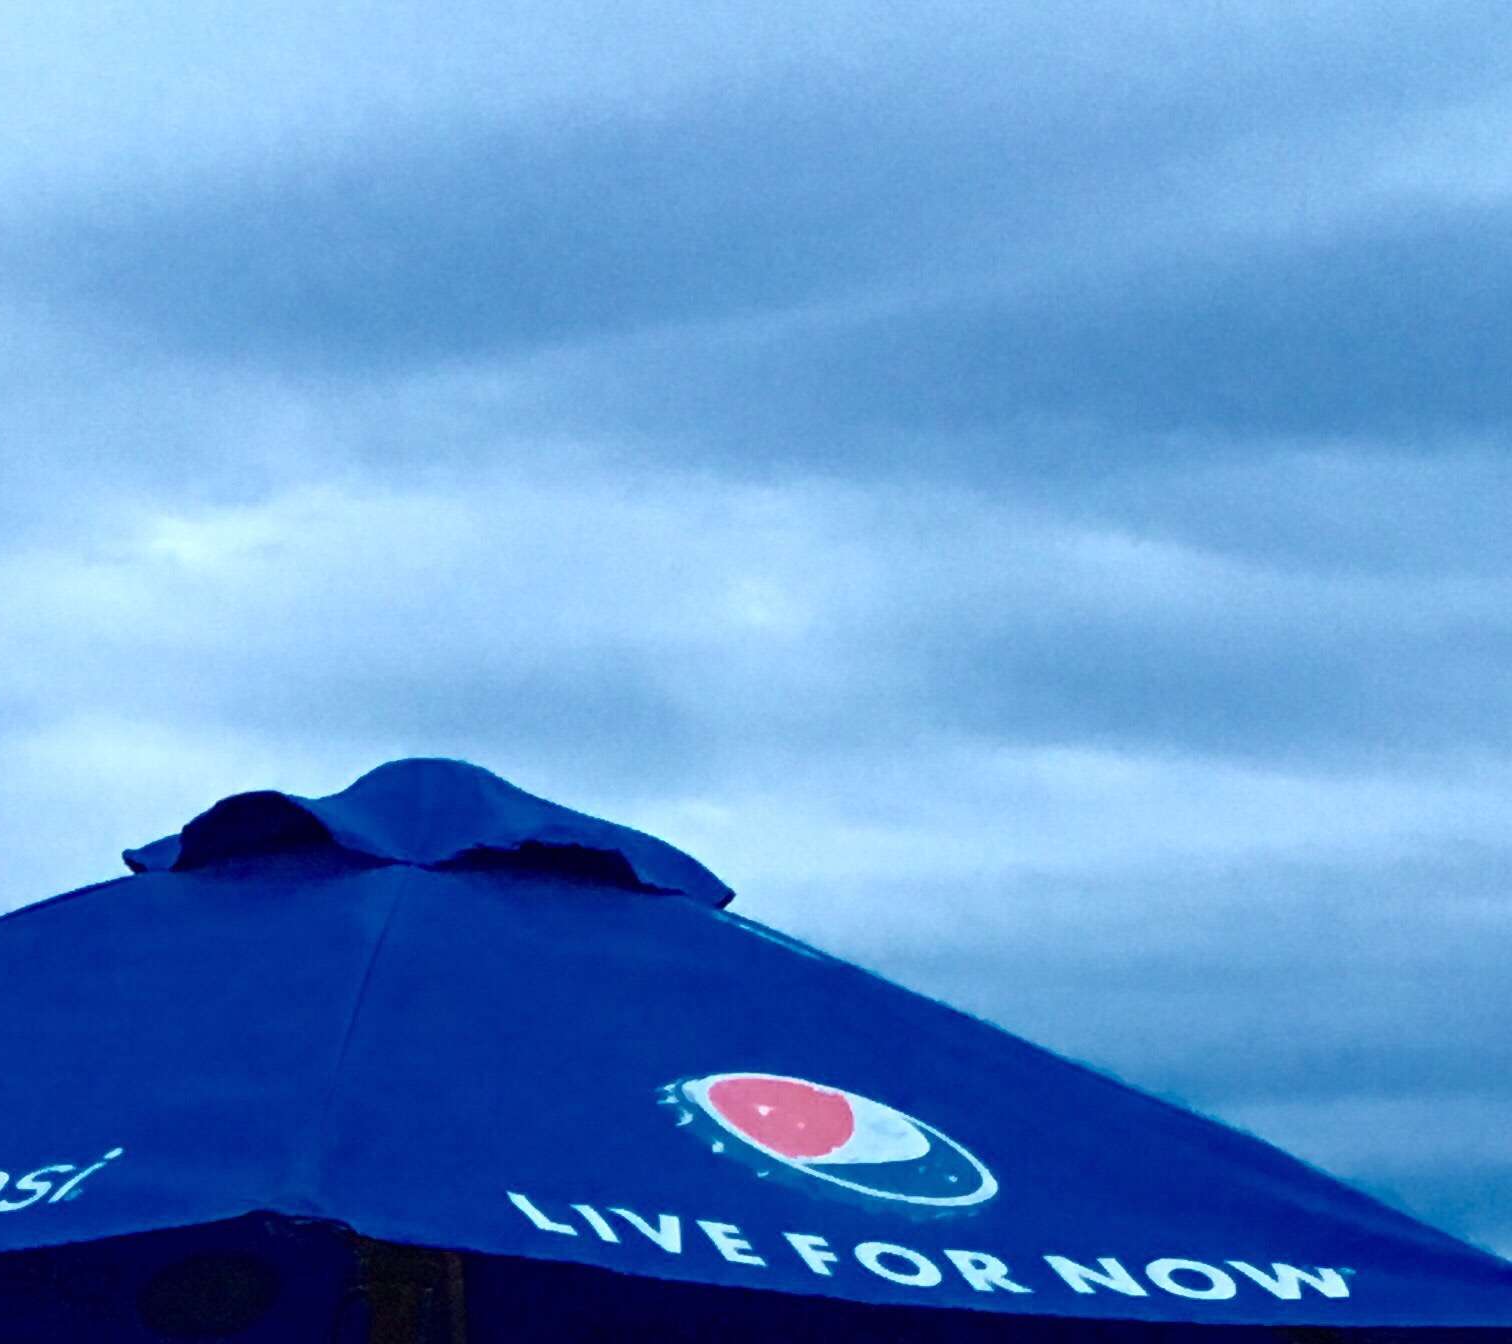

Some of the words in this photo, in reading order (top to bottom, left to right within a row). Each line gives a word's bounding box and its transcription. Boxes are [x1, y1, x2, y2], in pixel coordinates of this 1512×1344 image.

[506, 1191, 768, 1267] LIVE
[782, 1231, 1035, 1294] FOR
[1042, 1254, 1352, 1301] NOW
